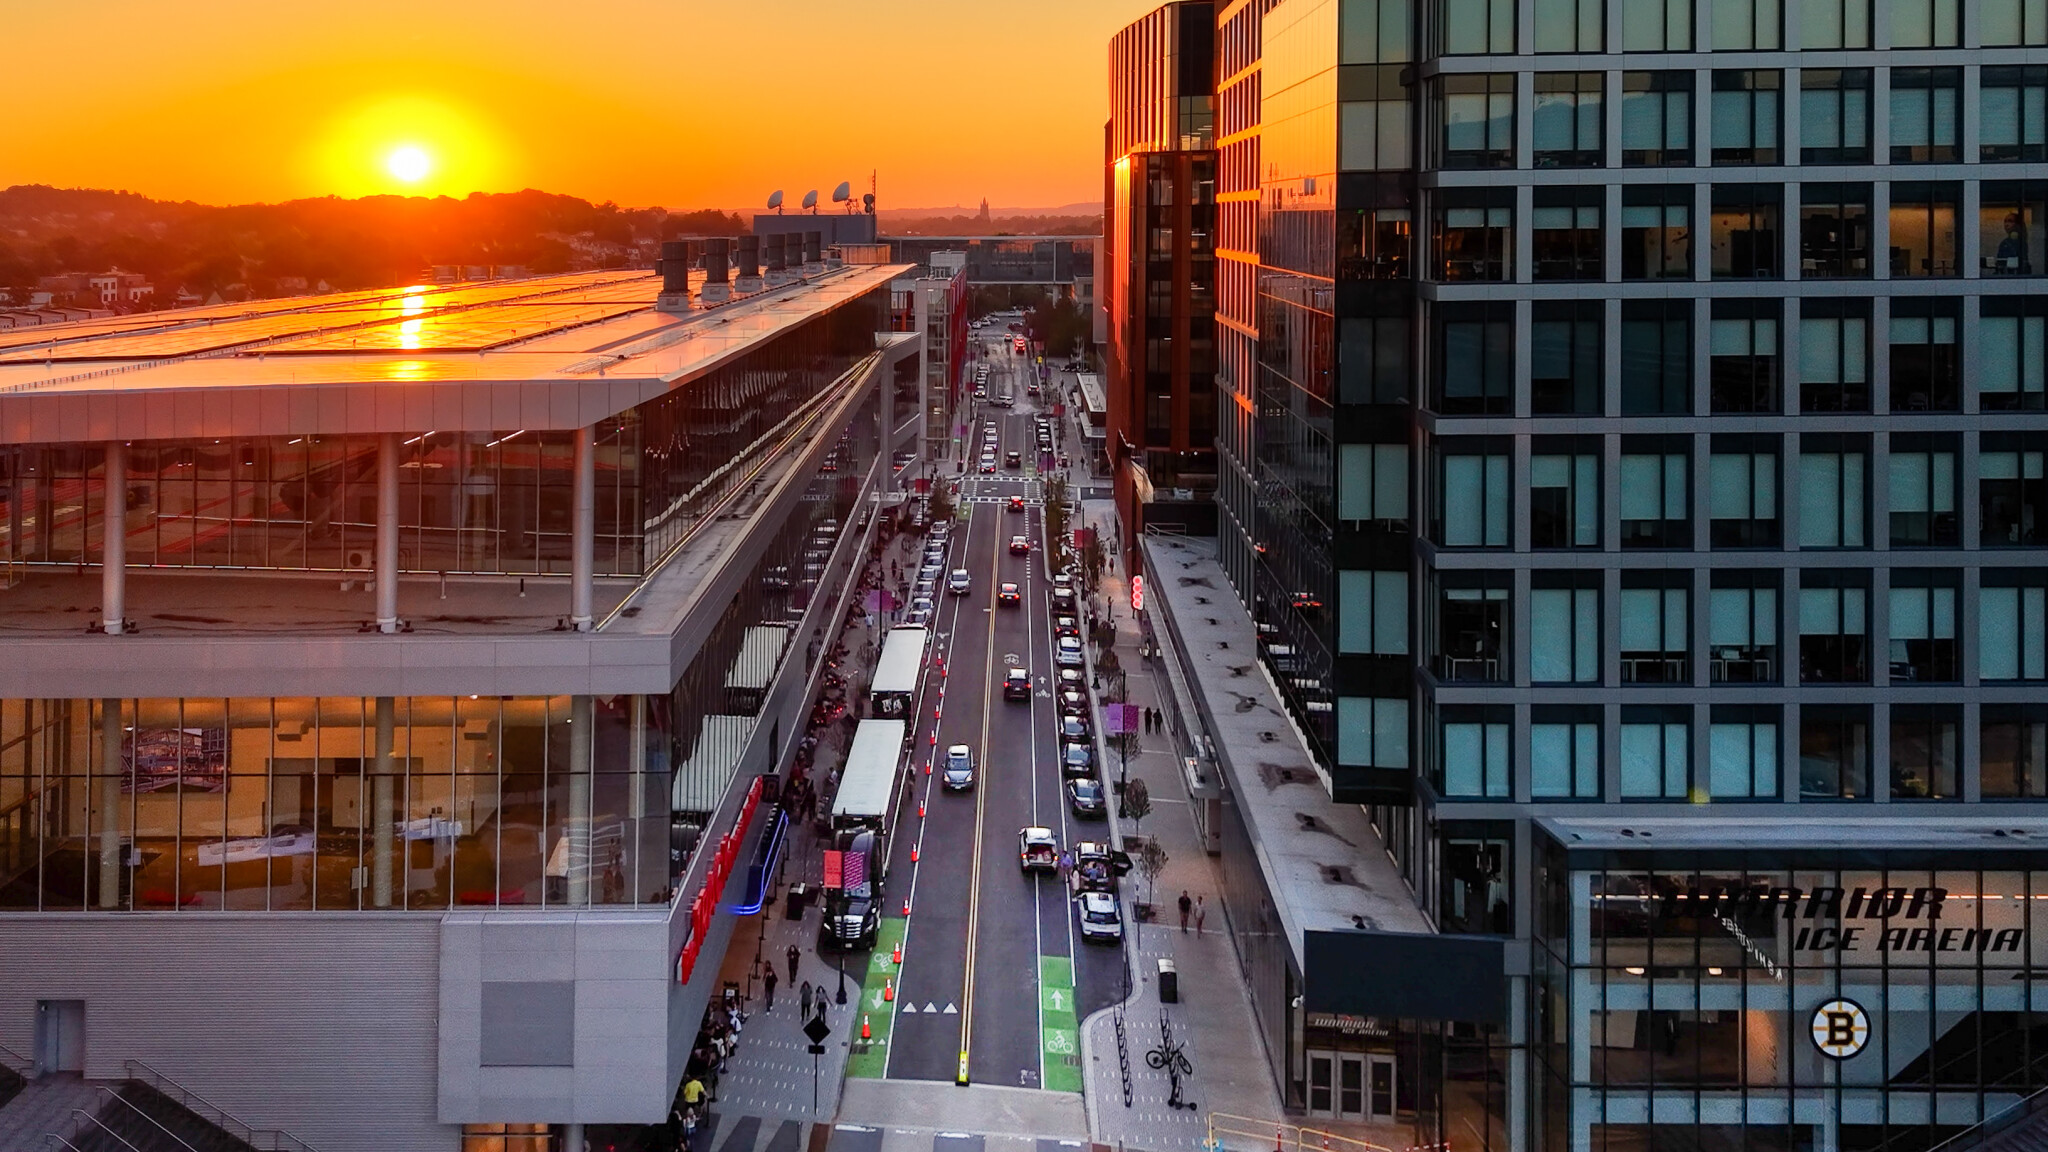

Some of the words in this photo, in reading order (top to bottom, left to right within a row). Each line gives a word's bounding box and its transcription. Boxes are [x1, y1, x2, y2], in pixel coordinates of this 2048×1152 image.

[1795, 927, 1865, 950] ICE
[1876, 928, 2024, 951] ARENA
[1827, 1011, 1854, 1046] B
